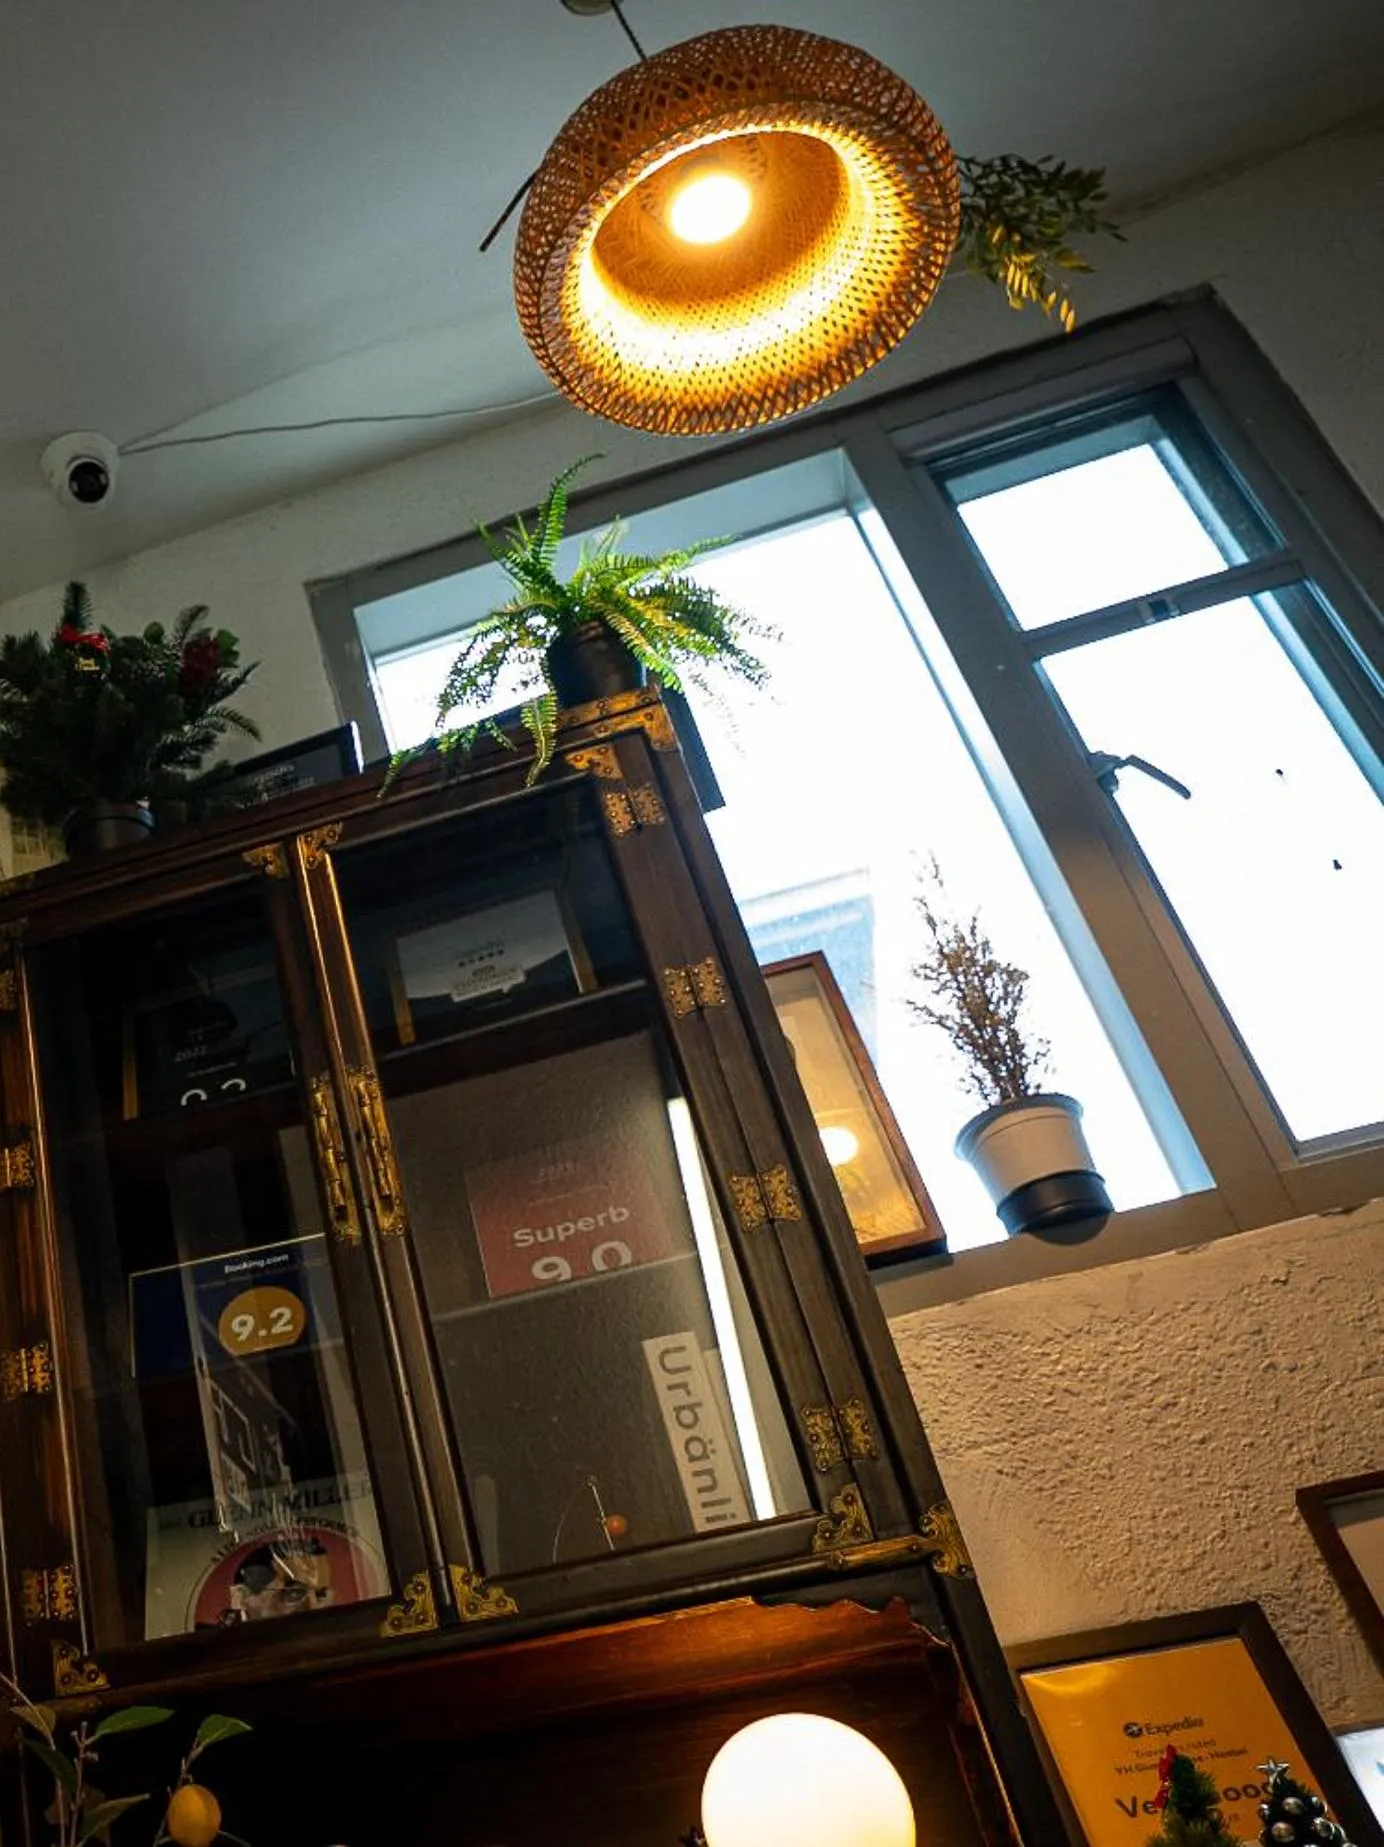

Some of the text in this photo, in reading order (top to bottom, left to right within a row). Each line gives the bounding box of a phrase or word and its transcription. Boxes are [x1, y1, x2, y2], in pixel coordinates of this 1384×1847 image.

[513, 1206, 630, 1248] Superb
[231, 1306, 294, 1342] 9.2
[1145, 1715, 1205, 1736] Expedia
[1114, 1796, 1161, 1819] Ve
